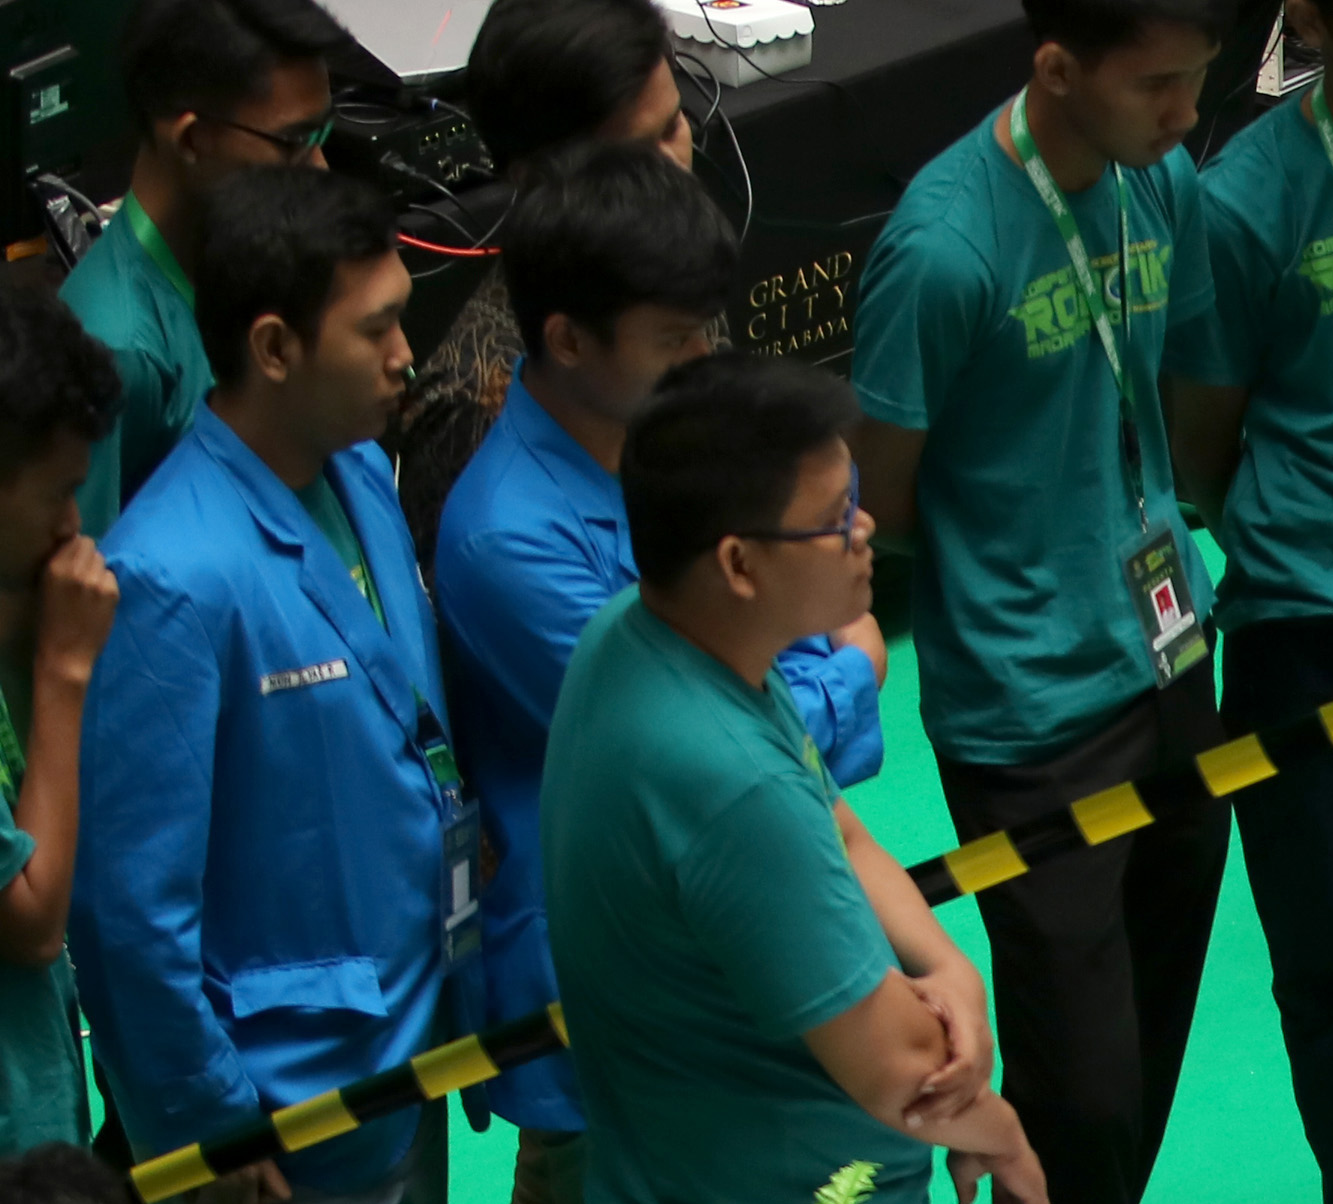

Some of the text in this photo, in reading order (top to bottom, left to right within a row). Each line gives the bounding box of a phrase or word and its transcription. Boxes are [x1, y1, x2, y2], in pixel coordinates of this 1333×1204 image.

[749, 251, 852, 308] GRAND
[748, 281, 850, 340] CITY
[751, 316, 849, 357] URABAYA
